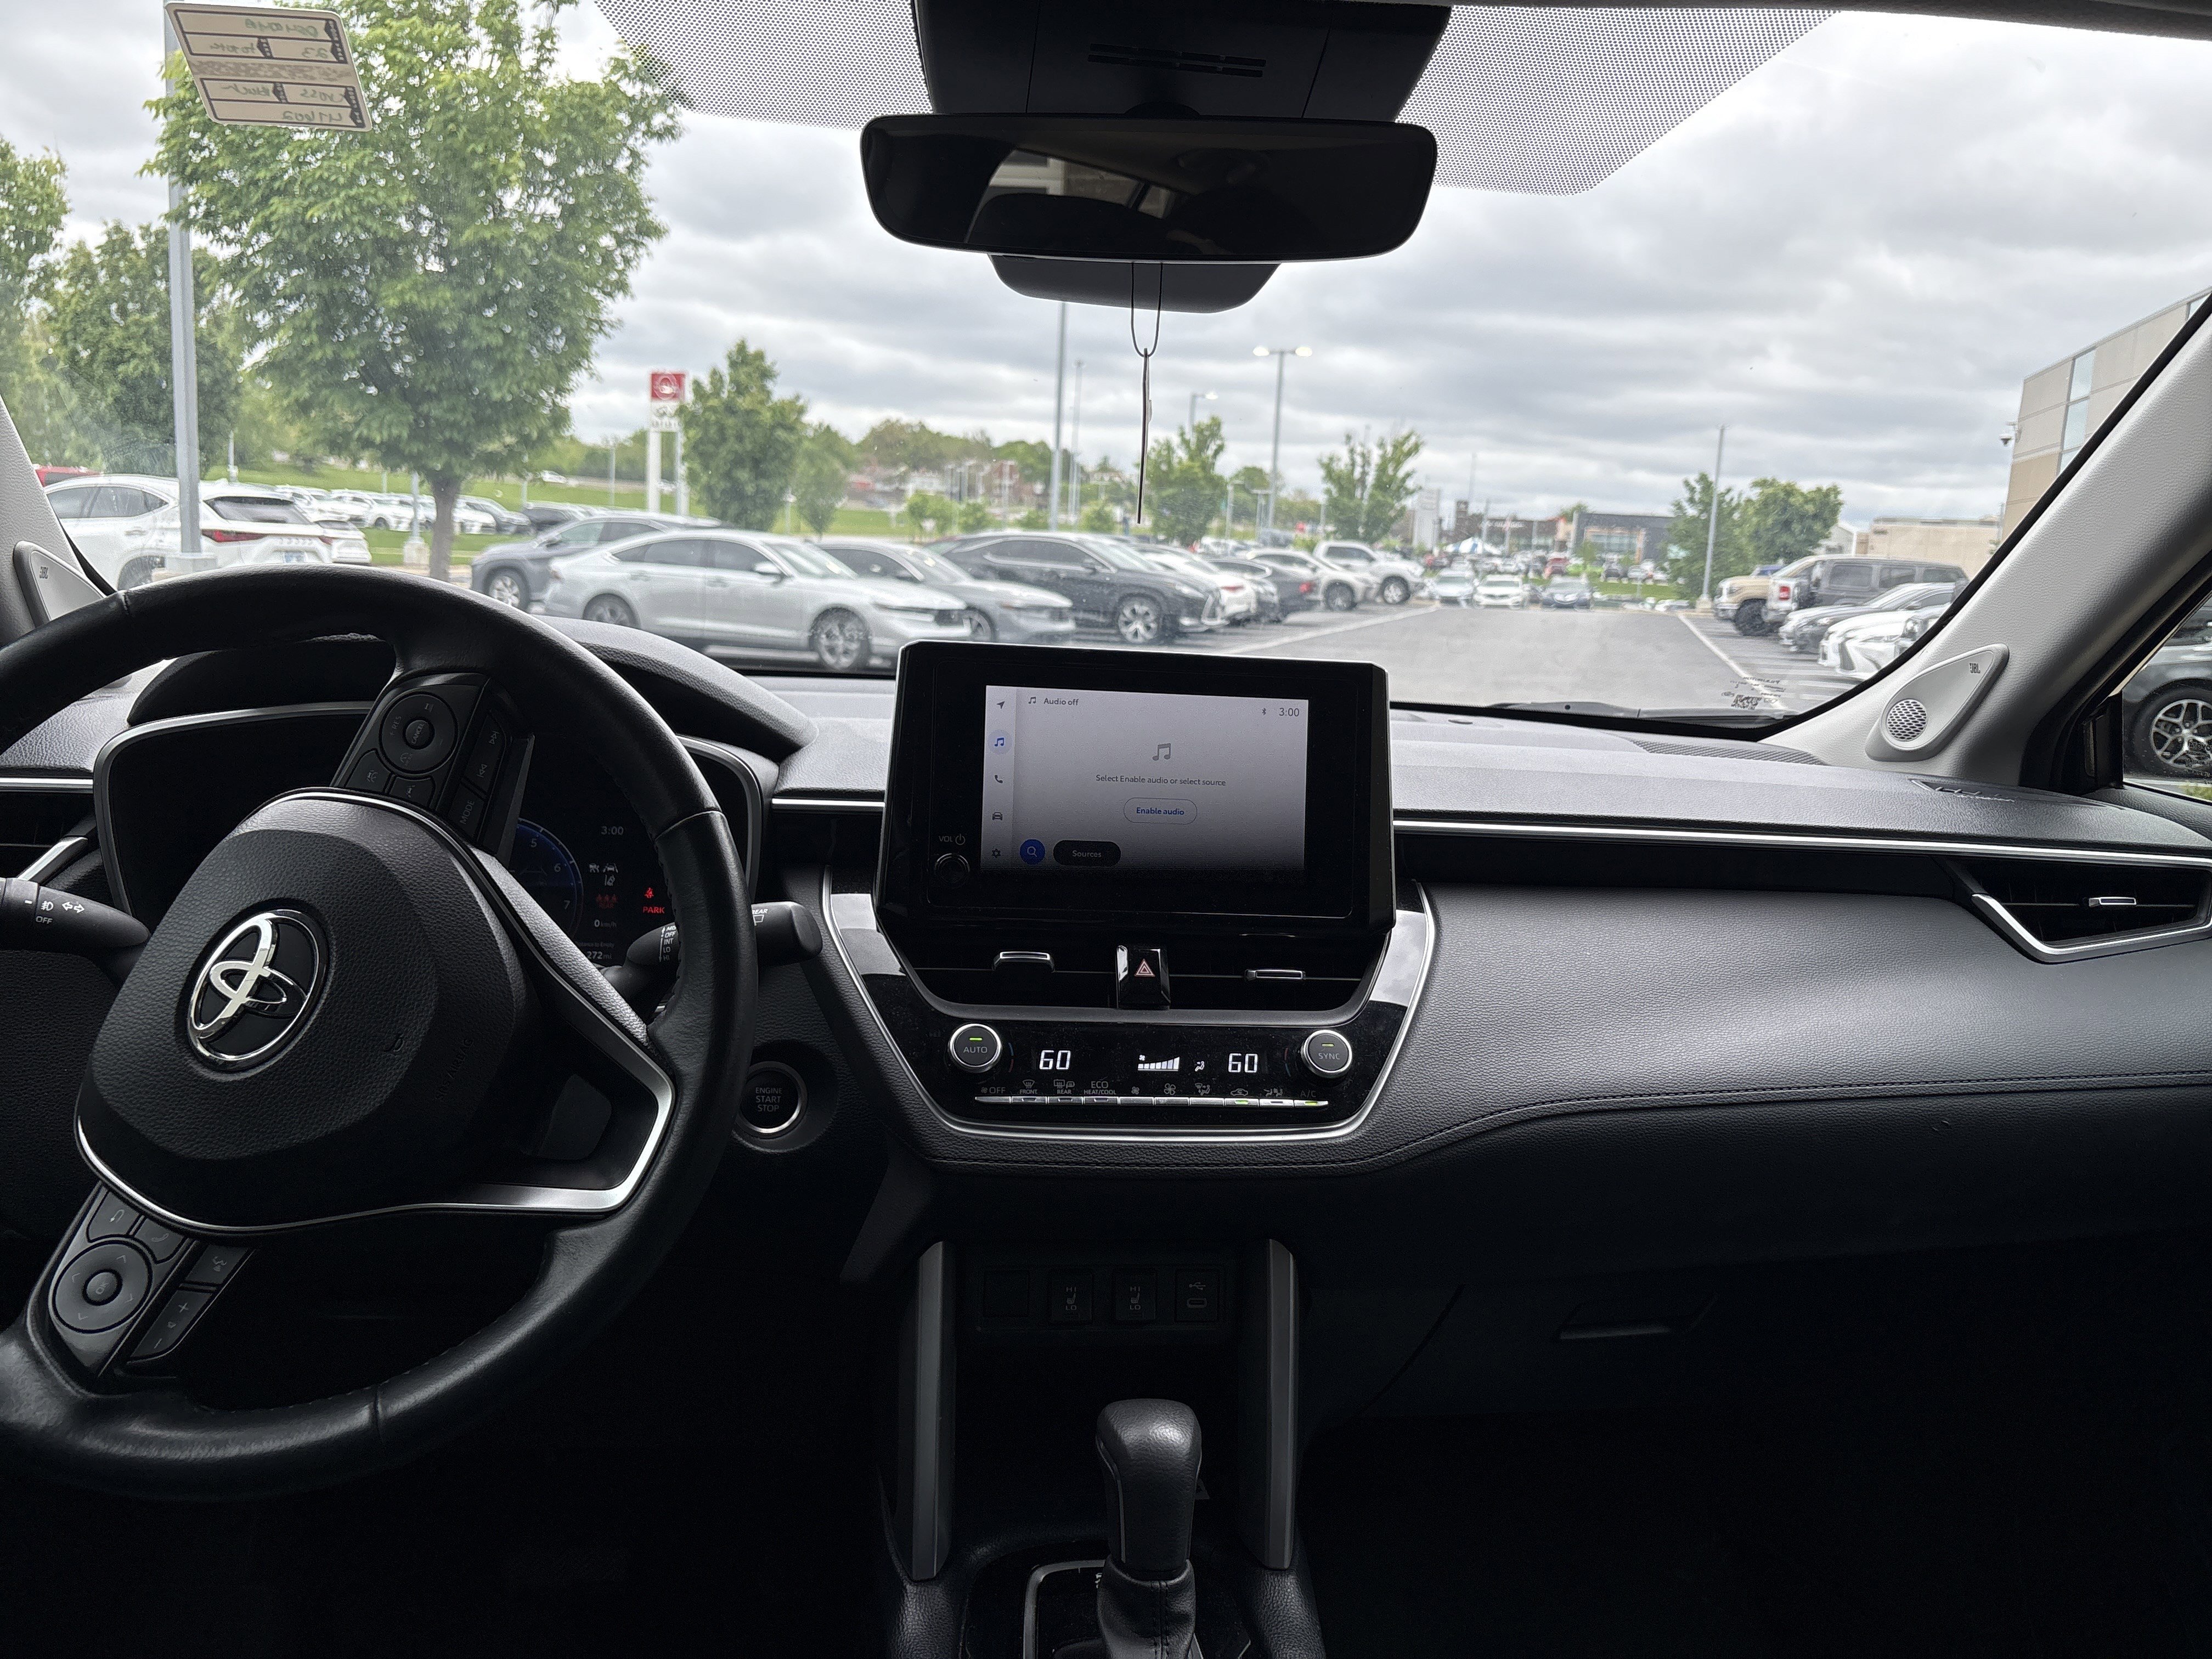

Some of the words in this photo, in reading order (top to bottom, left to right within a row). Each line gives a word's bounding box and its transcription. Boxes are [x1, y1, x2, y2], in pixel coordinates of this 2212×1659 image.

[1970, 663, 1980, 674] JBL
[1279, 707, 1300, 717] 3:00
[411, 723, 425, 744] CANCEL
[1096, 774, 1119, 782] Select
[1120, 775, 1146, 783] Enable
[460, 799, 476, 825] MODE
[601, 826, 624, 836] 3:00
[530, 838, 537, 848] 5
[554, 862, 561, 873] 6
[564, 900, 571, 910] 7
[642, 906, 665, 915] PARK
[35, 916, 53, 924] OFF
[594, 919, 600, 928] 0
[586, 951, 603, 960] 272
[1039, 1049, 1071, 1070] 60
[1228, 1053, 1258, 1073] 60
[1091, 1081, 1109, 1089] ECO
[1300, 1090, 1316, 1098] A/C
